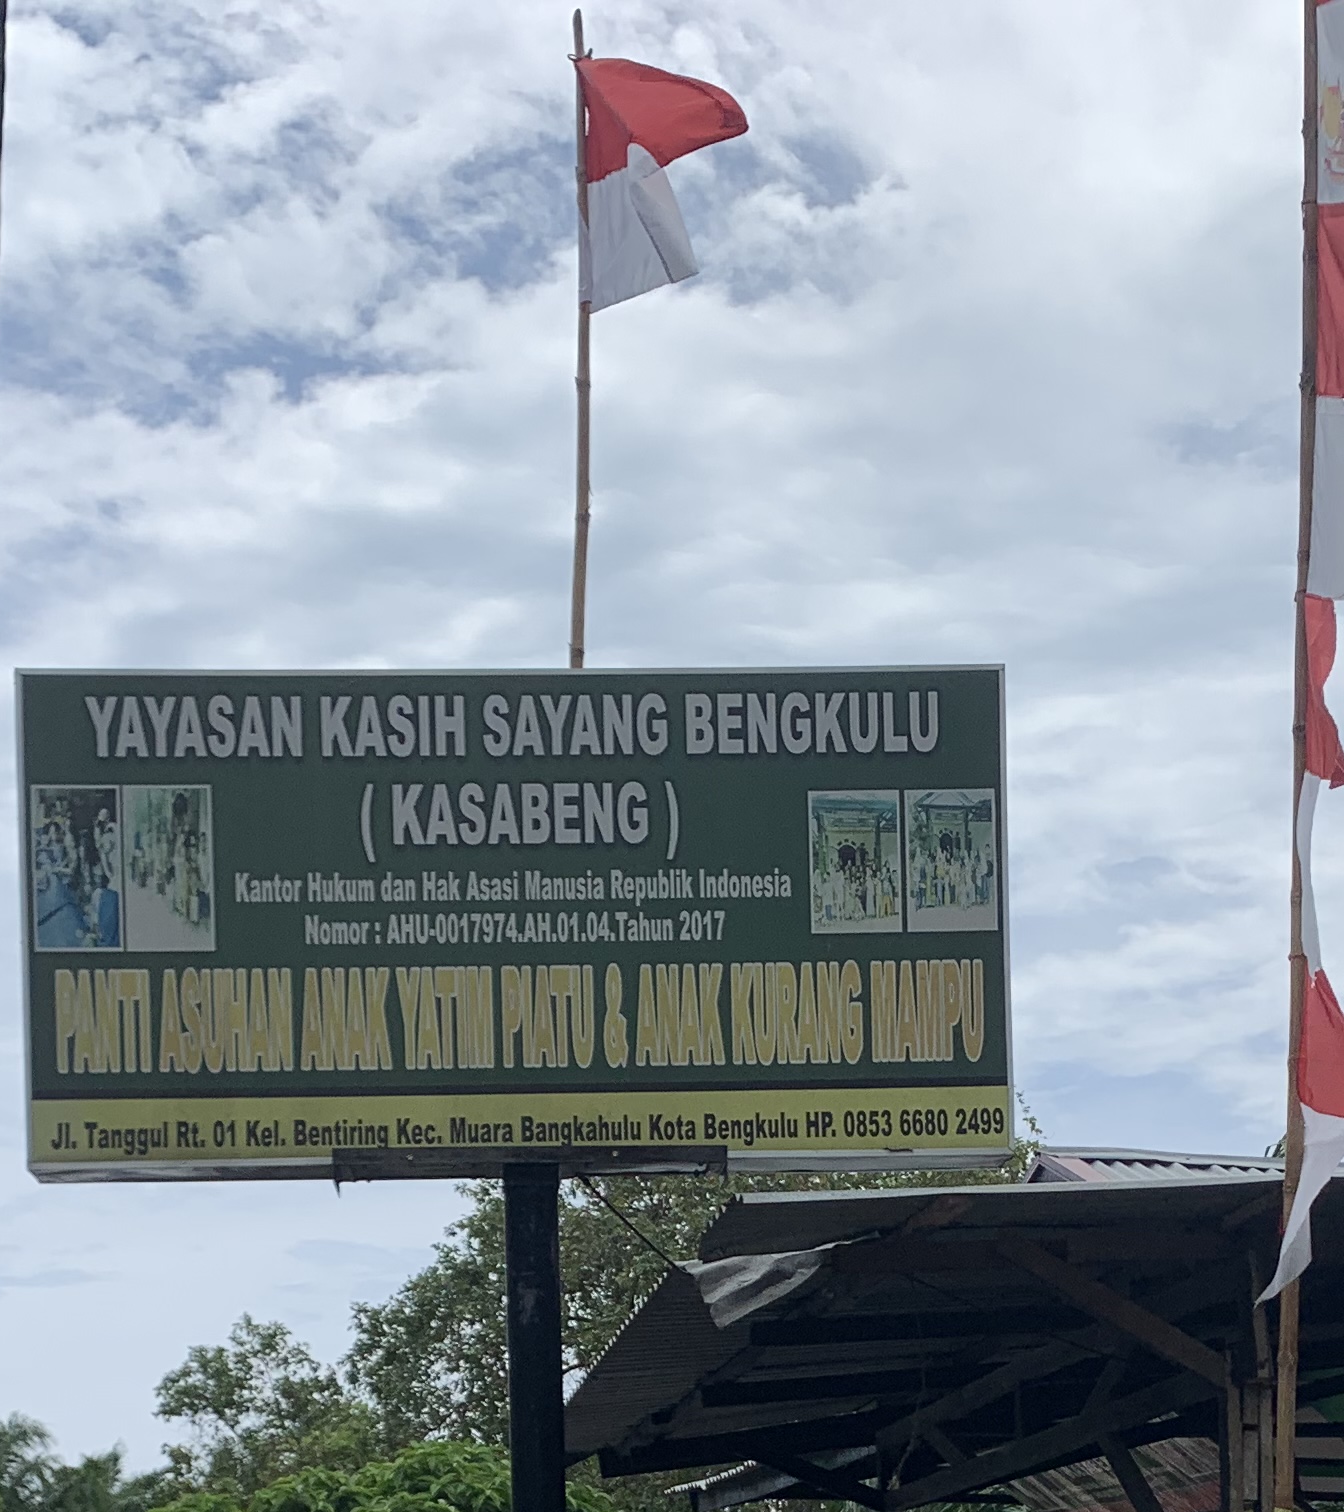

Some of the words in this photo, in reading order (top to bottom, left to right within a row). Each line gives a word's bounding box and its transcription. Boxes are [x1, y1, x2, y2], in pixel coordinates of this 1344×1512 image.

[84, 695, 303, 758] YAYASAN
[320, 695, 466, 757] KASIH
[482, 693, 669, 757] SAYANG
[684, 691, 940, 755] BENGKULU
[234, 872, 302, 902] Kantor
[307, 871, 375, 902] Hukum
[380, 871, 416, 901] dan
[422, 870, 460, 901] Hak
[466, 870, 519, 901] Asasi
[524, 869, 604, 900] Manusia
[610, 868, 694, 906] Republik
[699, 867, 792, 899] Indonesia
[304, 914, 369, 945] Nomor
[679, 910, 726, 941] 2017
[55, 967, 152, 1074] PANTI
[159, 966, 294, 1074] ASUHAN
[300, 966, 393, 1072] ANAK
[396, 965, 495, 1071] YATIM
[500, 963, 594, 1069] PIATU
[603, 963, 629, 1069] &
[636, 962, 726, 1067] ANAK
[730, 960, 864, 1066] KURANG
[870, 958, 985, 1063] MAMPU
[84, 1121, 169, 1156] Tanggul
[176, 1120, 205, 1148] Rt.
[213, 1120, 236, 1147] 01
[245, 1120, 286, 1147] Kel.
[294, 1118, 389, 1148] Bentiring
[396, 1117, 442, 1145] Kec.
[449, 1116, 514, 1144] Muara
[521, 1114, 642, 1147] Bangkahulu
[648, 1113, 696, 1141] Kota
[705, 1111, 799, 1146] Bengkulu
[805, 1111, 837, 1138] HP.
[843, 1109, 892, 1137] 0853
[899, 1108, 948, 1136] 6680
[955, 1107, 1005, 1135] 2499
